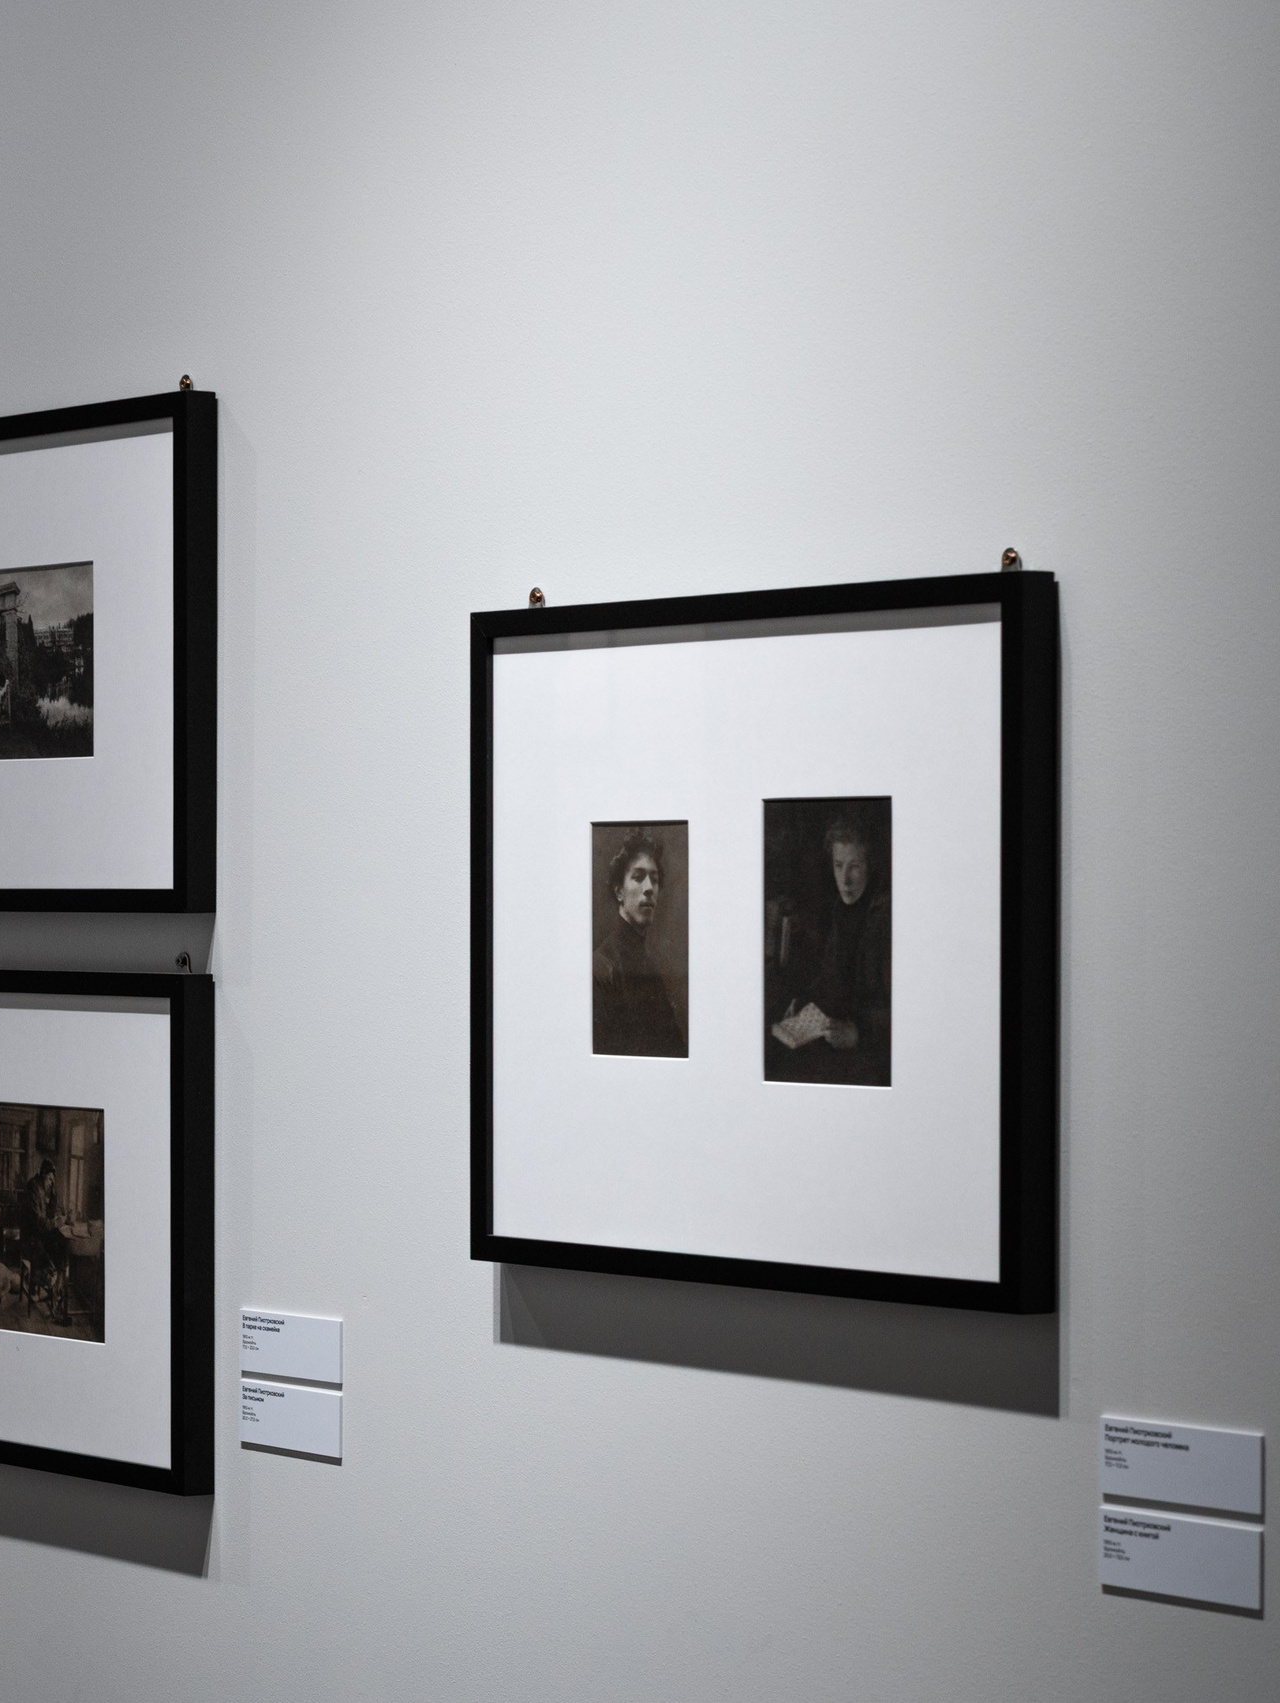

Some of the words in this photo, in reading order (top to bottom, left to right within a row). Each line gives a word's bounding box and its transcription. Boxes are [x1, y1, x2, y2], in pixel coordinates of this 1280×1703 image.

[242, 1314, 258, 1322] Евгений
[242, 1385, 258, 1393] Евгений
[1104, 1424, 1128, 1433] Евгений
[1104, 1433, 1129, 1444] Портрет
[1130, 1438, 1160, 1448] молодого
[1103, 1514, 1127, 1525] Евгений
[1103, 1525, 1132, 1537] Женщина
[1138, 1531, 1160, 1540] книгой
